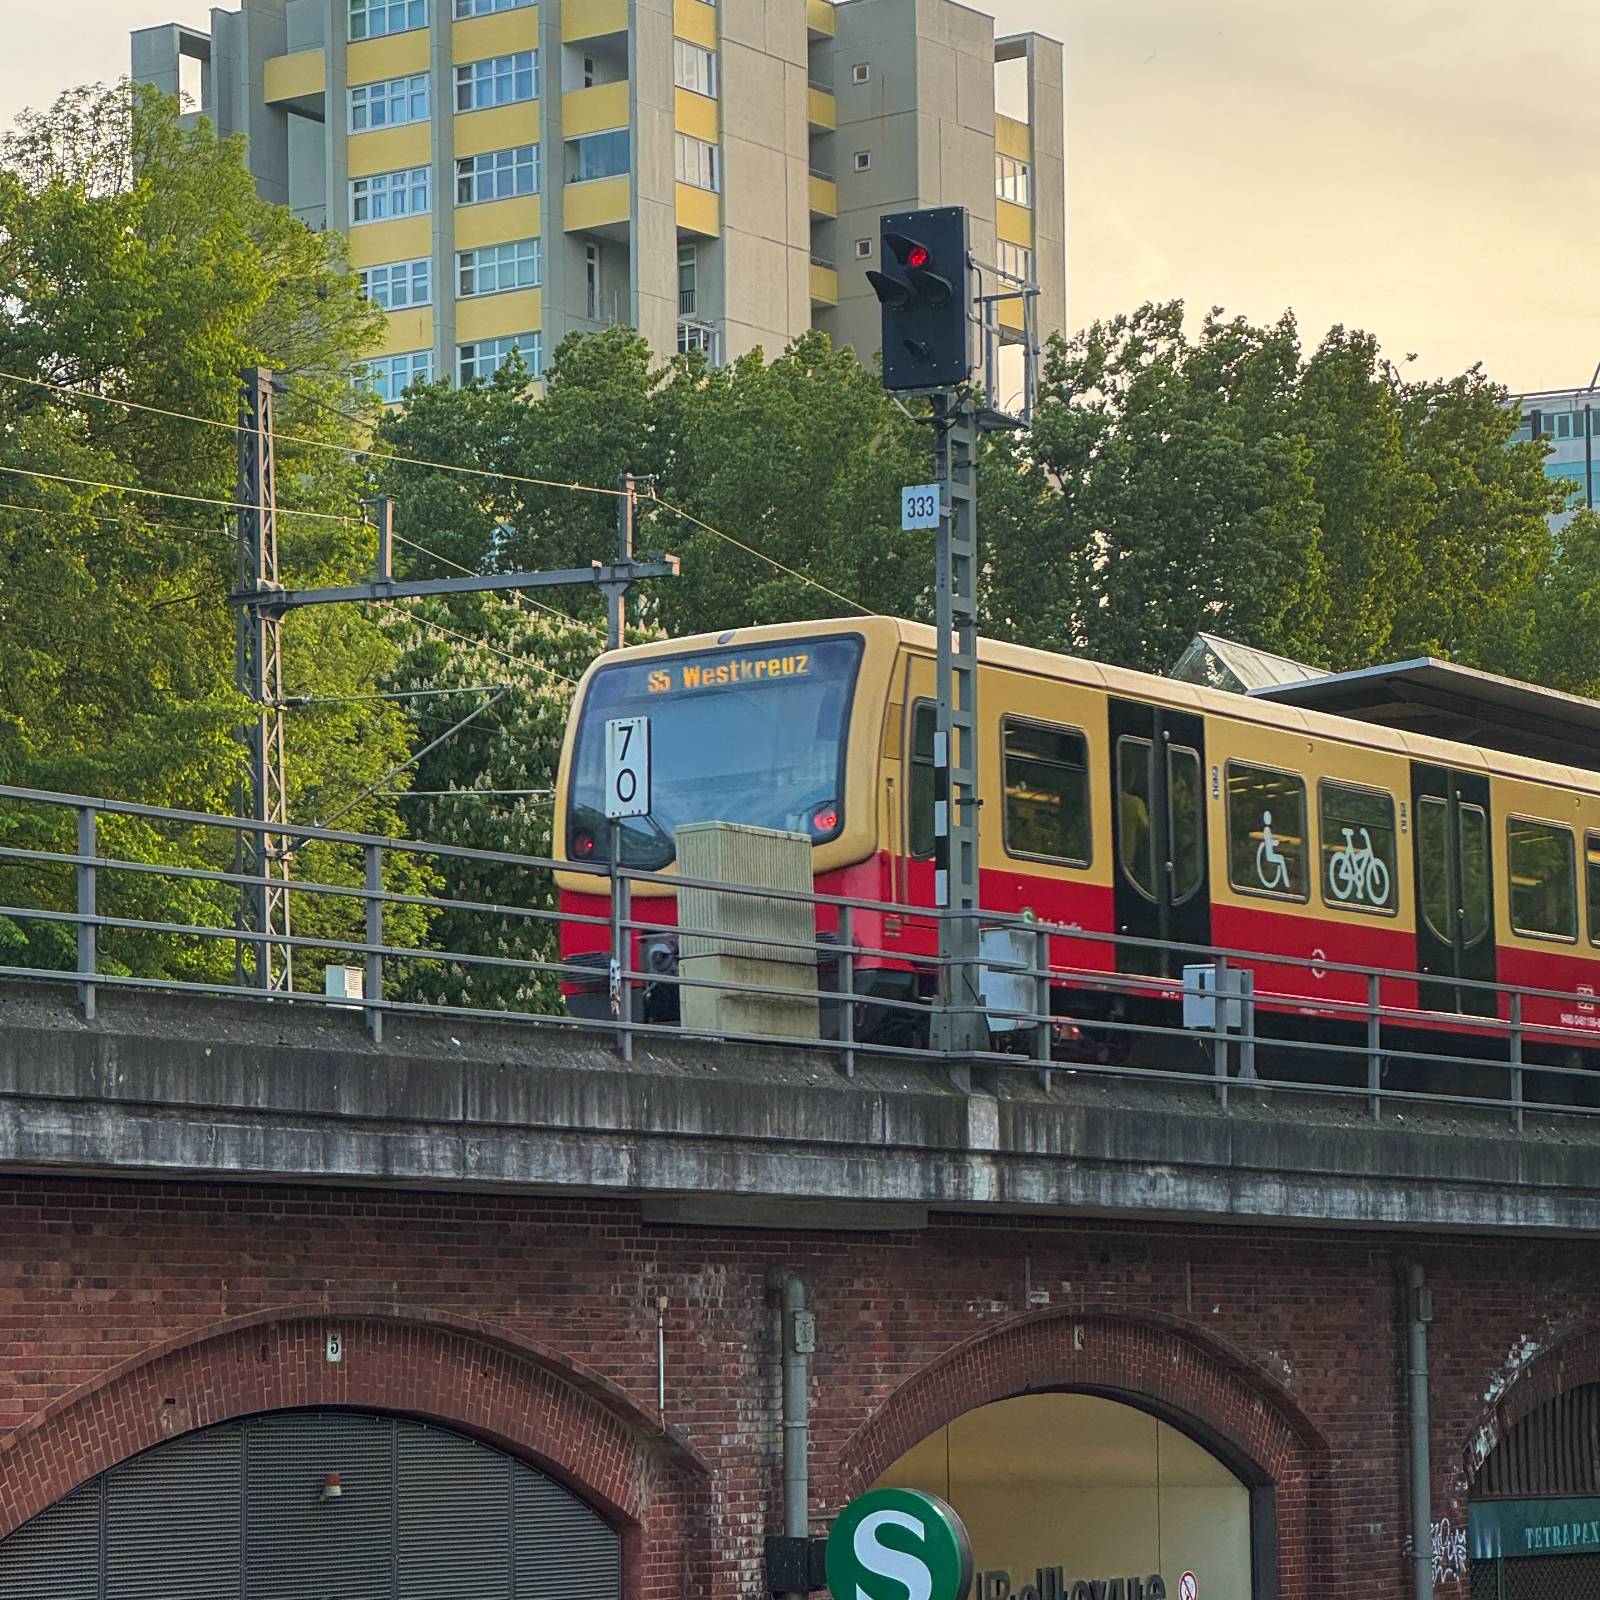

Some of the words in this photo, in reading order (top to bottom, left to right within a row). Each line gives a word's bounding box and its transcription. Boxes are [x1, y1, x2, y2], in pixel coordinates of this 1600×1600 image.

[907, 496, 934, 518] 333
[648, 668, 671, 692] S5
[683, 655, 810, 688] Westkreuz
[618, 725, 634, 761] 7
[616, 768, 637, 802] 0
[331, 1335, 339, 1355] 5
[1525, 1520, 1600, 1549] TETRAPAX
[853, 1510, 932, 1600] S
